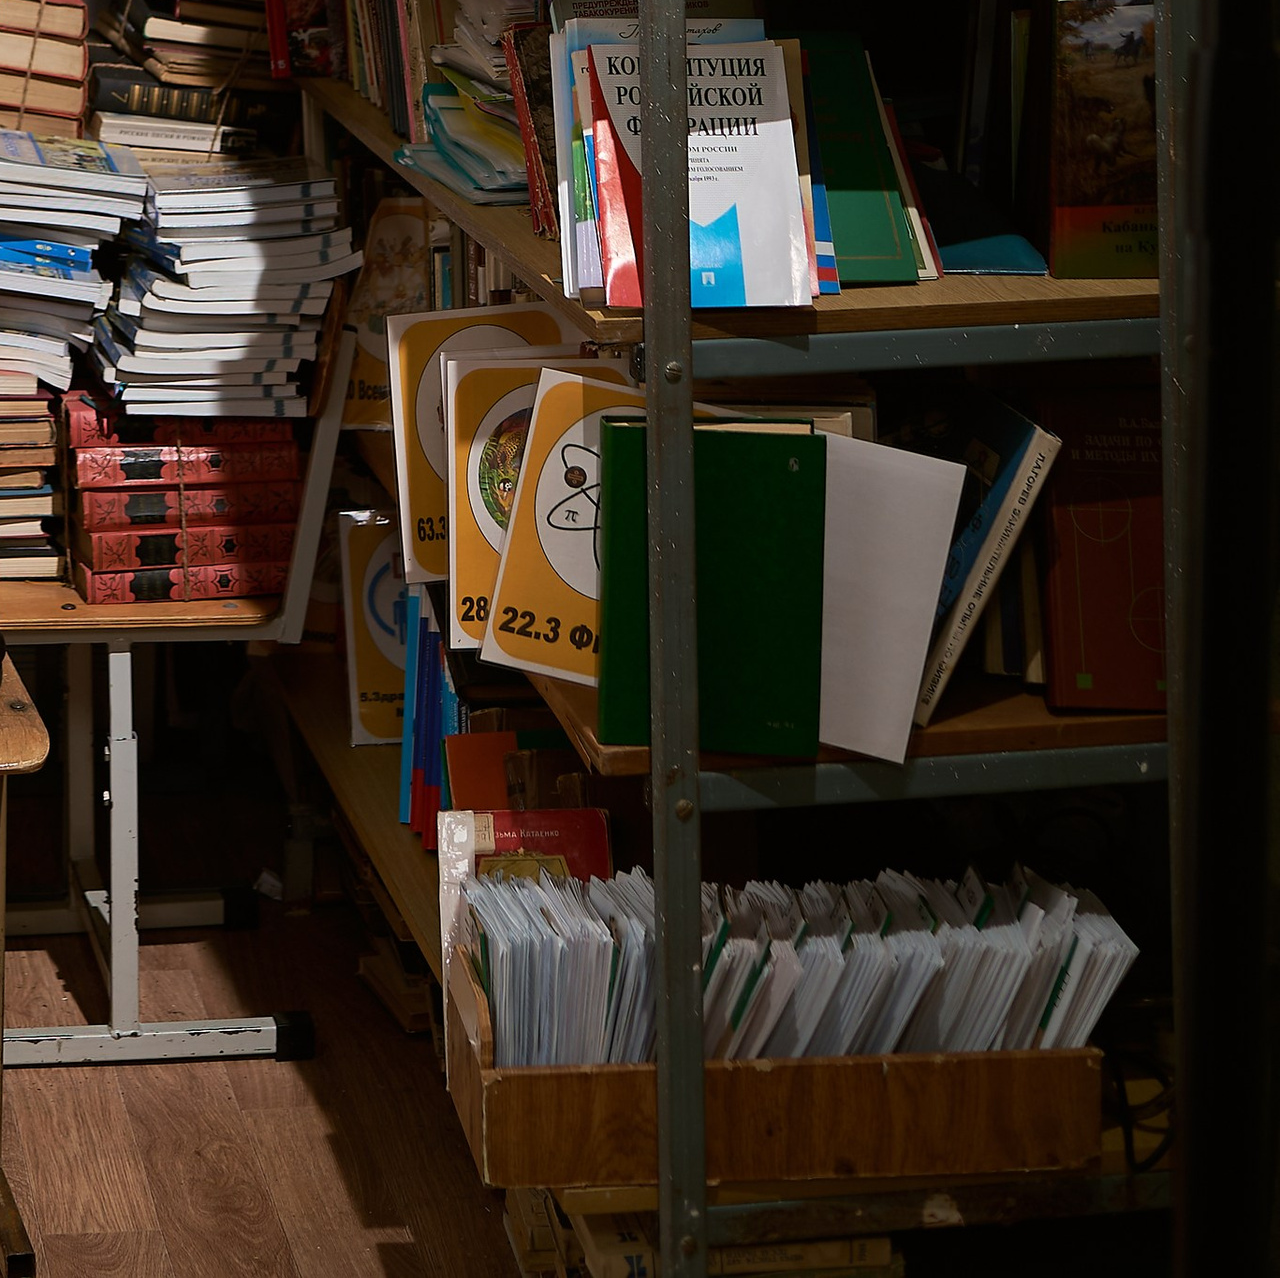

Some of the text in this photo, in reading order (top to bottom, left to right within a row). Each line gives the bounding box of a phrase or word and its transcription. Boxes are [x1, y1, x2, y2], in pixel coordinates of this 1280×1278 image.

[606, 55, 767, 80] КОИТУЦИЯ
[615, 82, 765, 107] РОЙСКОЙ
[626, 115, 760, 140] ФРАЦИИ
[701, 145, 738, 153] РОССИИ
[971, 508, 1022, 601] ЗАНИМАТЕЛЬНЫЕ
[498, 605, 562, 643] 22.3
